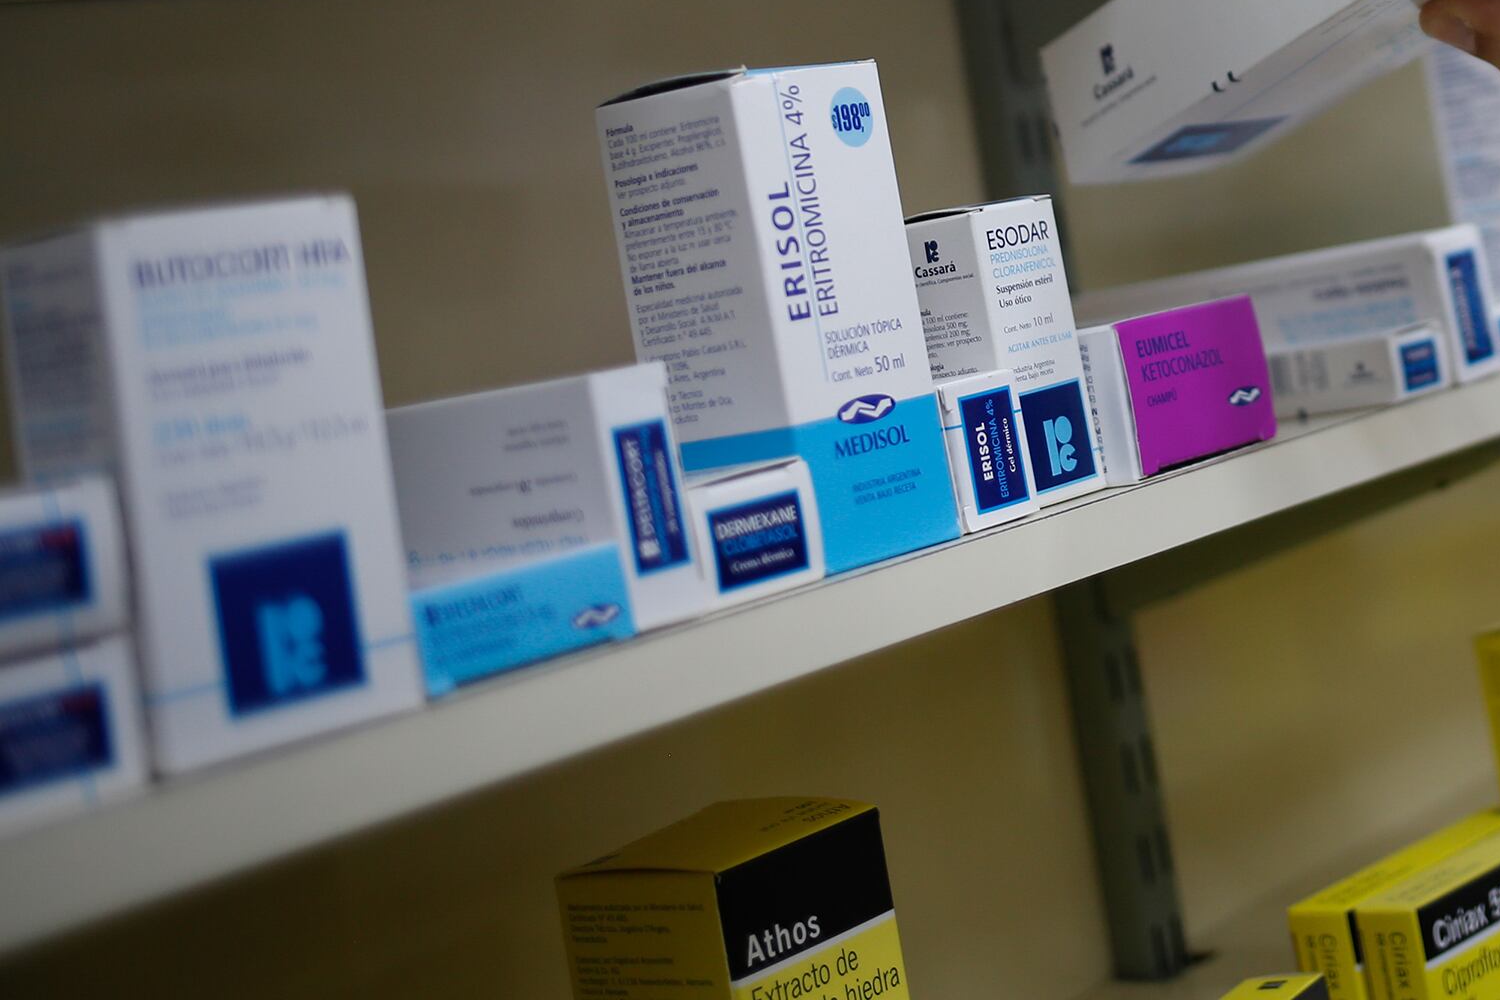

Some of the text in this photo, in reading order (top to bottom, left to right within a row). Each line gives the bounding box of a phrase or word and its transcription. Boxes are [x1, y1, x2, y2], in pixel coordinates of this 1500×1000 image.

[780, 85, 839, 316] ERITROMICINA 4%
[986, 220, 1050, 250] ESODAR
[768, 182, 812, 321] ERISOL
[990, 244, 1048, 265] PREDNISOLONA
[914, 260, 956, 278] Cassará
[993, 258, 1056, 279] CLORANFENICOL
[996, 273, 1053, 295] Suspensión estéril
[999, 293, 1032, 308] Uso ótico
[825, 318, 902, 344] SOLUCIÓN TÓPICA
[1033, 316, 1043, 327] 10
[1044, 312, 1054, 324] ml
[827, 341, 869, 359] DÉRMICA
[1008, 342, 1030, 354] AGITAR
[1031, 337, 1050, 348] ANTES
[1050, 335, 1058, 345] DE
[1135, 330, 1190, 358] EUMICEL
[855, 366, 873, 378] Neto
[874, 355, 890, 373] 50
[892, 353, 905, 369] ml
[1014, 359, 1055, 374] ndustria Argentina
[1141, 348, 1225, 383] KETOCONAZOL
[834, 424, 911, 459] MEDISOL
[975, 422, 994, 481] ERISOL
[986, 399, 1009, 498] ERITROMICINA 4%
[1002, 418, 1016, 473] Gel dérmico
[716, 505, 797, 540] DERMEXANE
[747, 915, 821, 968] Athos
[1432, 906, 1487, 949] Ciriax
[836, 948, 859, 977] de
